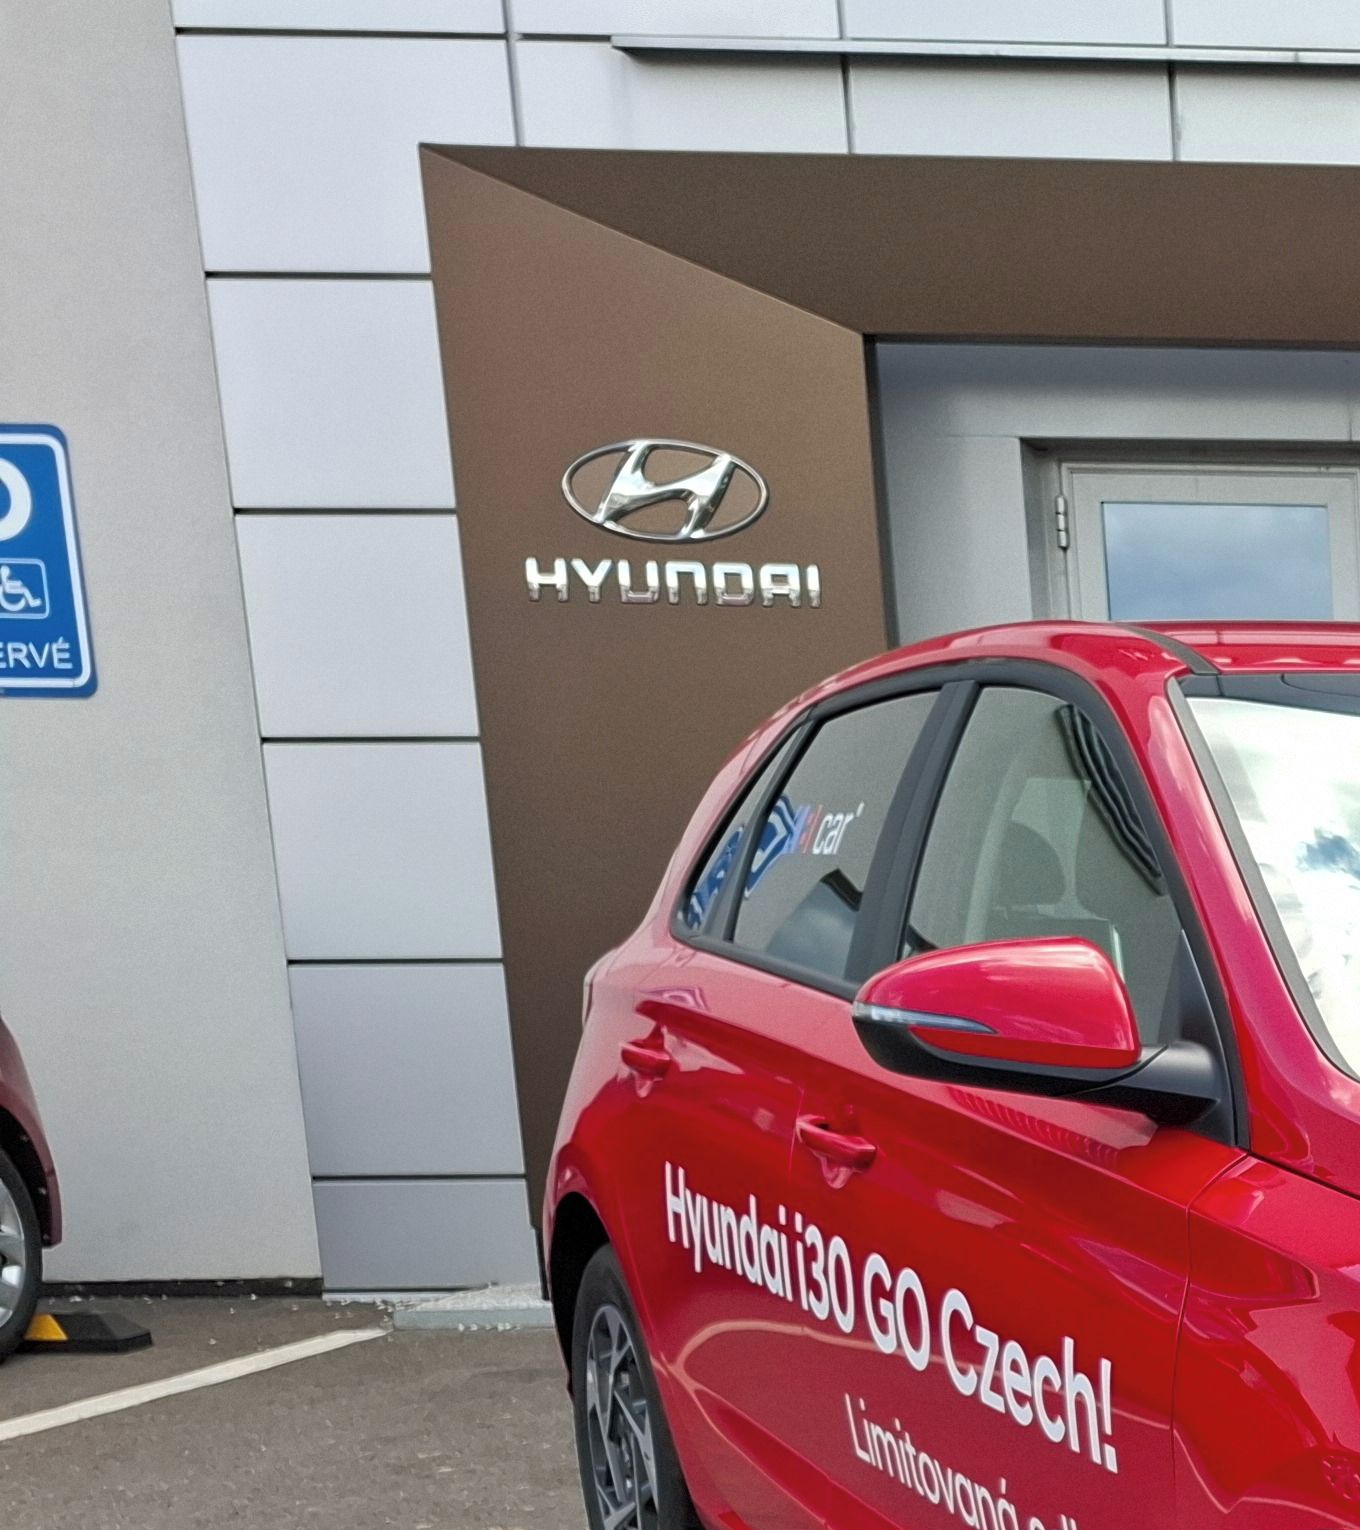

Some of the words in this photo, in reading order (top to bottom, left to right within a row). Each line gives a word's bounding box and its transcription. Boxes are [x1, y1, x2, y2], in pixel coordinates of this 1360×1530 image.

[525, 556, 822, 608] HYUNDAI
[664, 1161, 794, 1302] Hyundai
[795, 1212, 856, 1333] i30
[863, 1253, 930, 1371] GO
[941, 1288, 1119, 1474] Czech!
